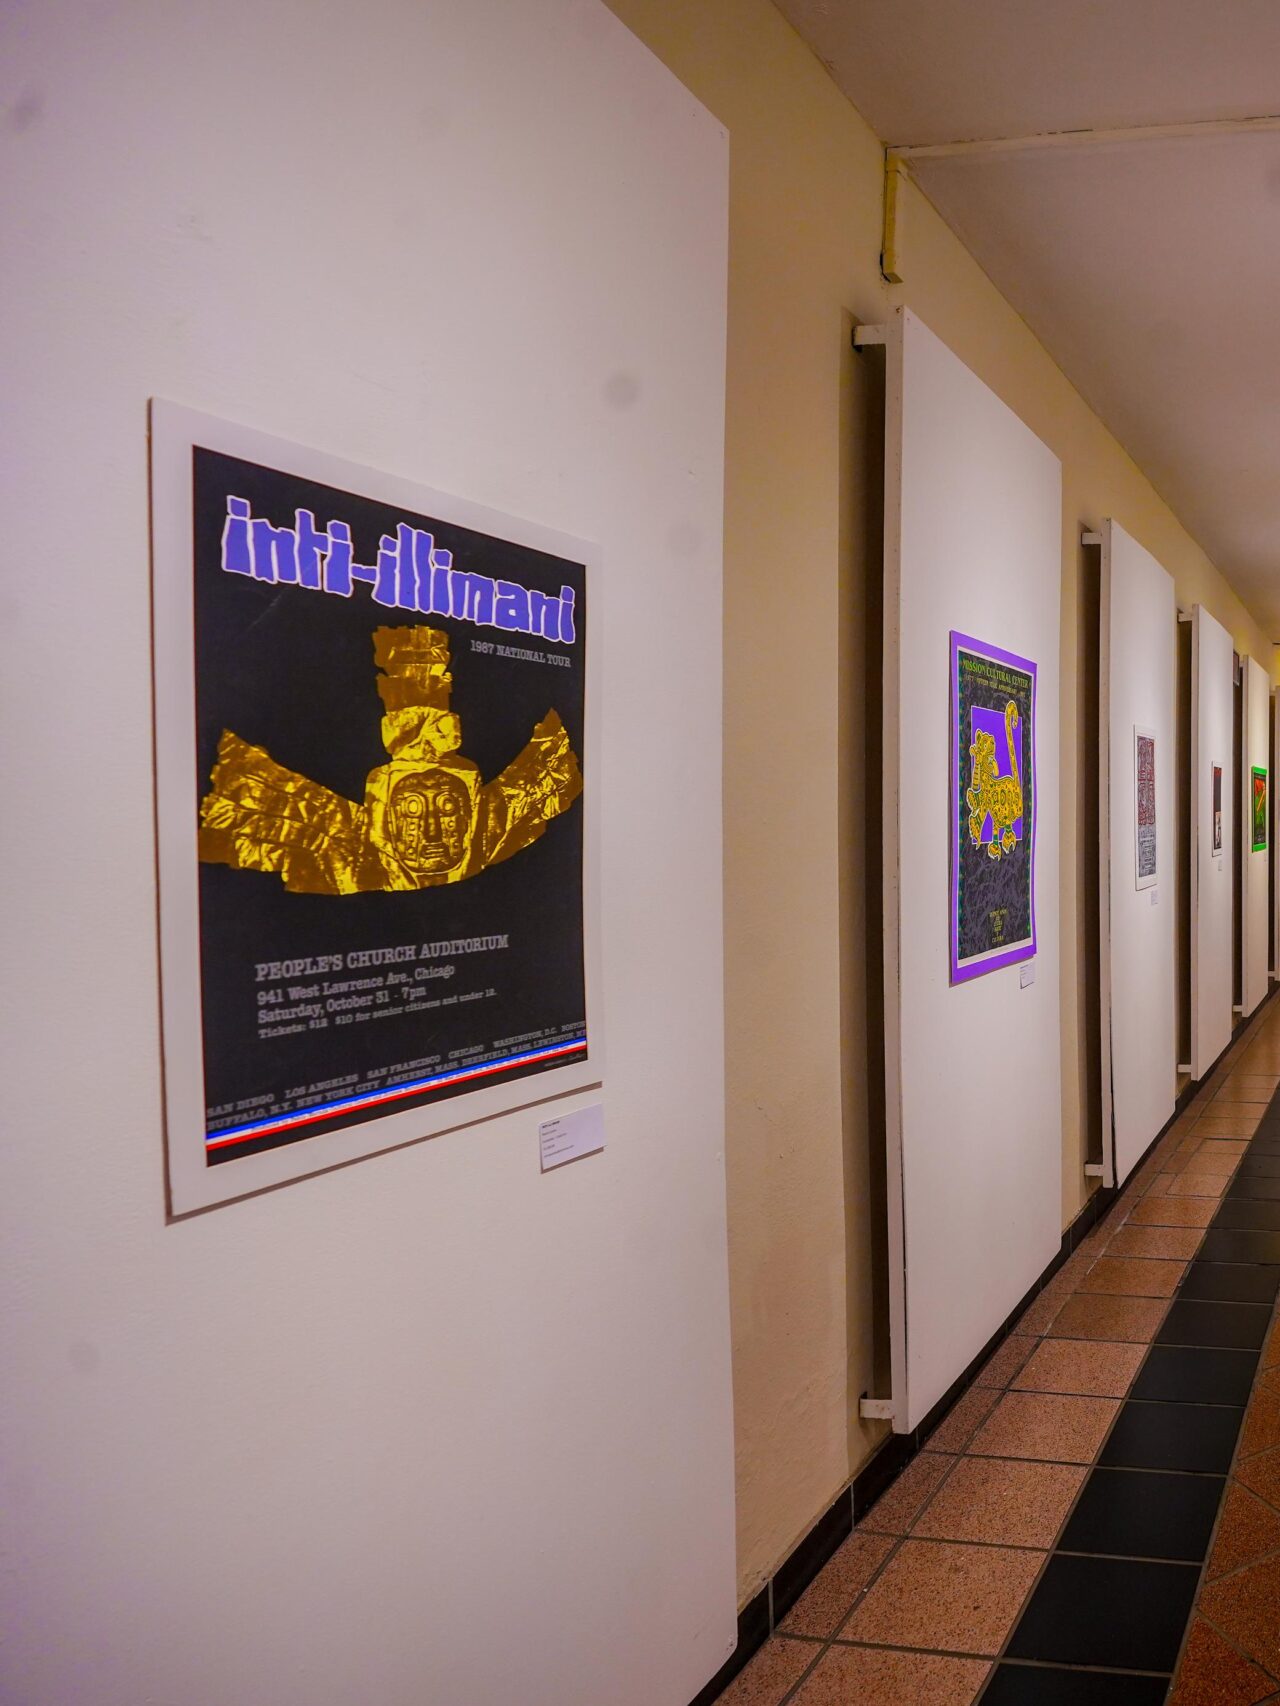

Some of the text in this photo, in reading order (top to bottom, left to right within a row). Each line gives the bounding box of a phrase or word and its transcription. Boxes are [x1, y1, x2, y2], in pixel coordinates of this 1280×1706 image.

[470, 639, 571, 667] 1987 NATIONAL TOUR
[254, 934, 509, 982] PEOPLE'S CHURCH AUDITORIUM
[257, 988, 284, 1006] 941
[287, 984, 321, 1001] West
[322, 977, 383, 995] Lawrence
[414, 964, 455, 979] Chicago
[258, 1003, 325, 1024] Saturday,
[326, 994, 373, 1012] October
[376, 990, 390, 1004] 31
[401, 986, 427, 1001] 7pm
[355, 1012, 371, 1022] for
[372, 1006, 403, 1018] senior
[404, 999, 441, 1012] citizens
[442, 995, 458, 1005] and
[459, 991, 484, 1002] under
[207, 1103, 235, 1118] SAN
[236, 1093, 275, 1110] DIEGO
[284, 1086, 307, 1099] LOS
[308, 1073, 359, 1092] ANGELES
[366, 1070, 389, 1079] SAN
[389, 1054, 441, 1073] FRANCISCO
[448, 1045, 484, 1059] CHICAGO
[296, 1094, 323, 1108] NEW
[324, 1086, 354, 1101] YORK
[355, 1081, 380, 1093] CITY
